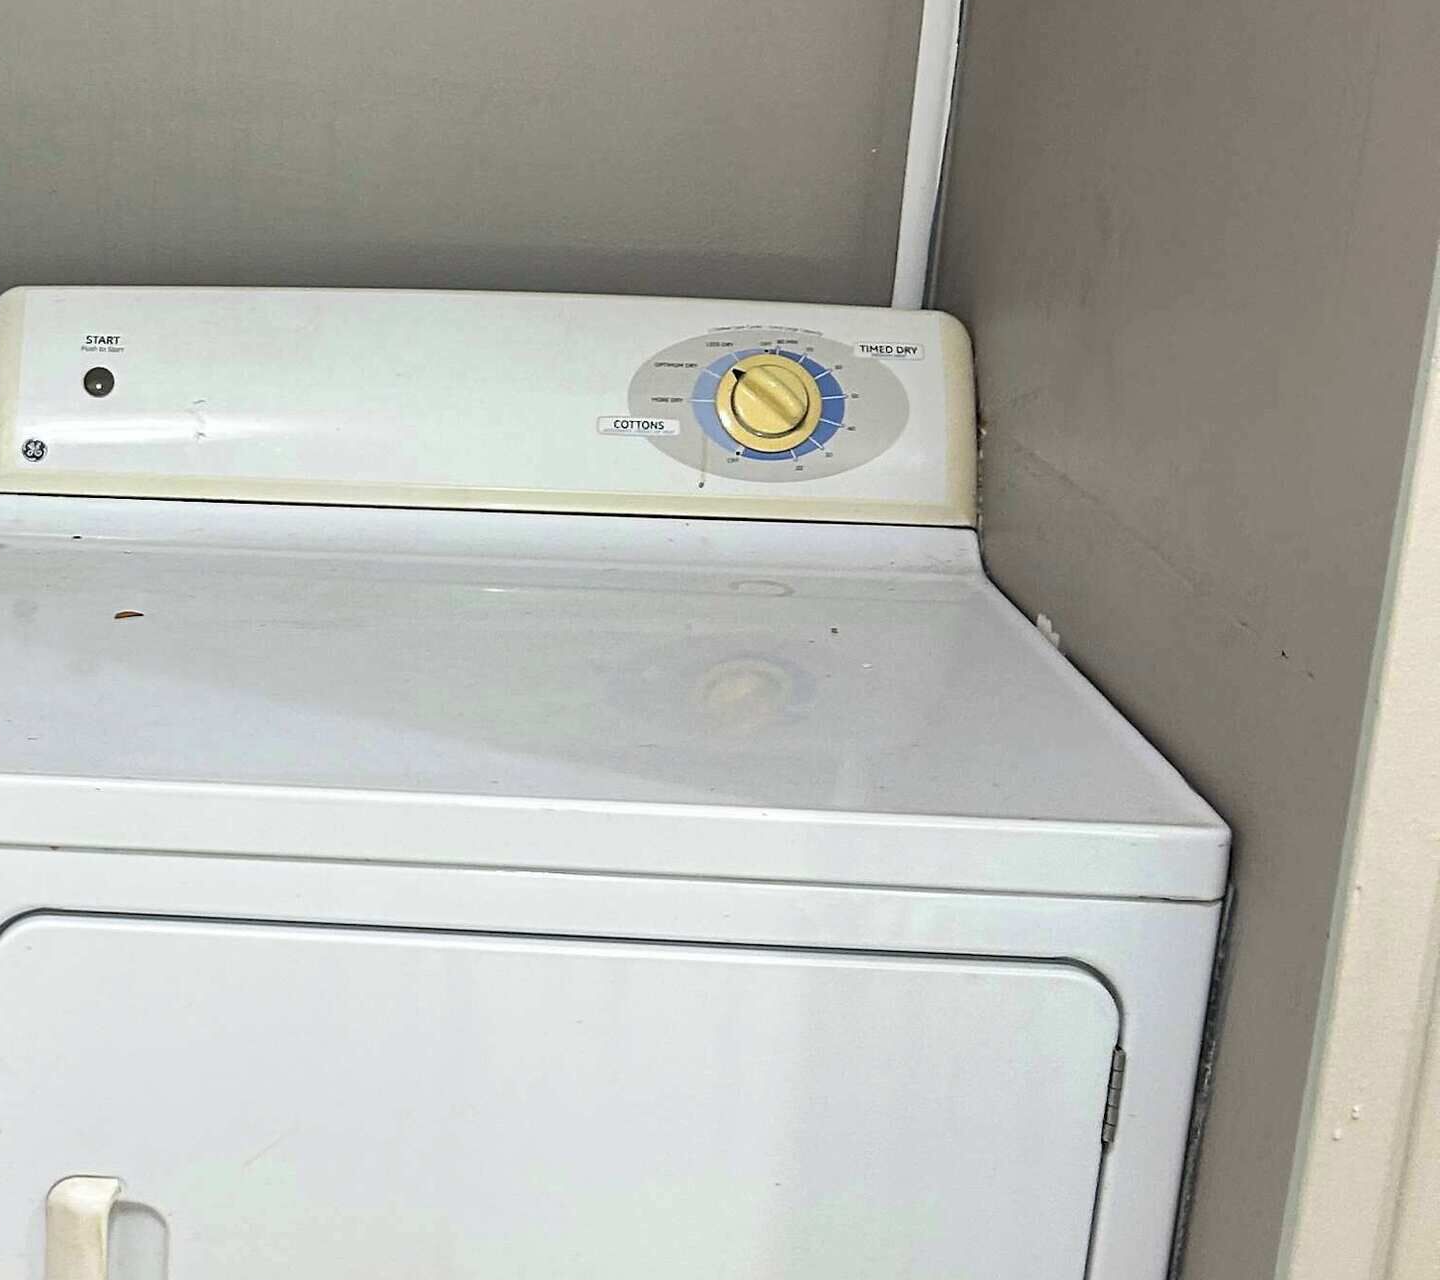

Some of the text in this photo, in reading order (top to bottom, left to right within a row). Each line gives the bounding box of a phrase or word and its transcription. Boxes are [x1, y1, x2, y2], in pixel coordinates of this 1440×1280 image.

[86, 335, 121, 344] START
[859, 344, 918, 355] TIMED DRY
[612, 419, 665, 430] COTTONS
